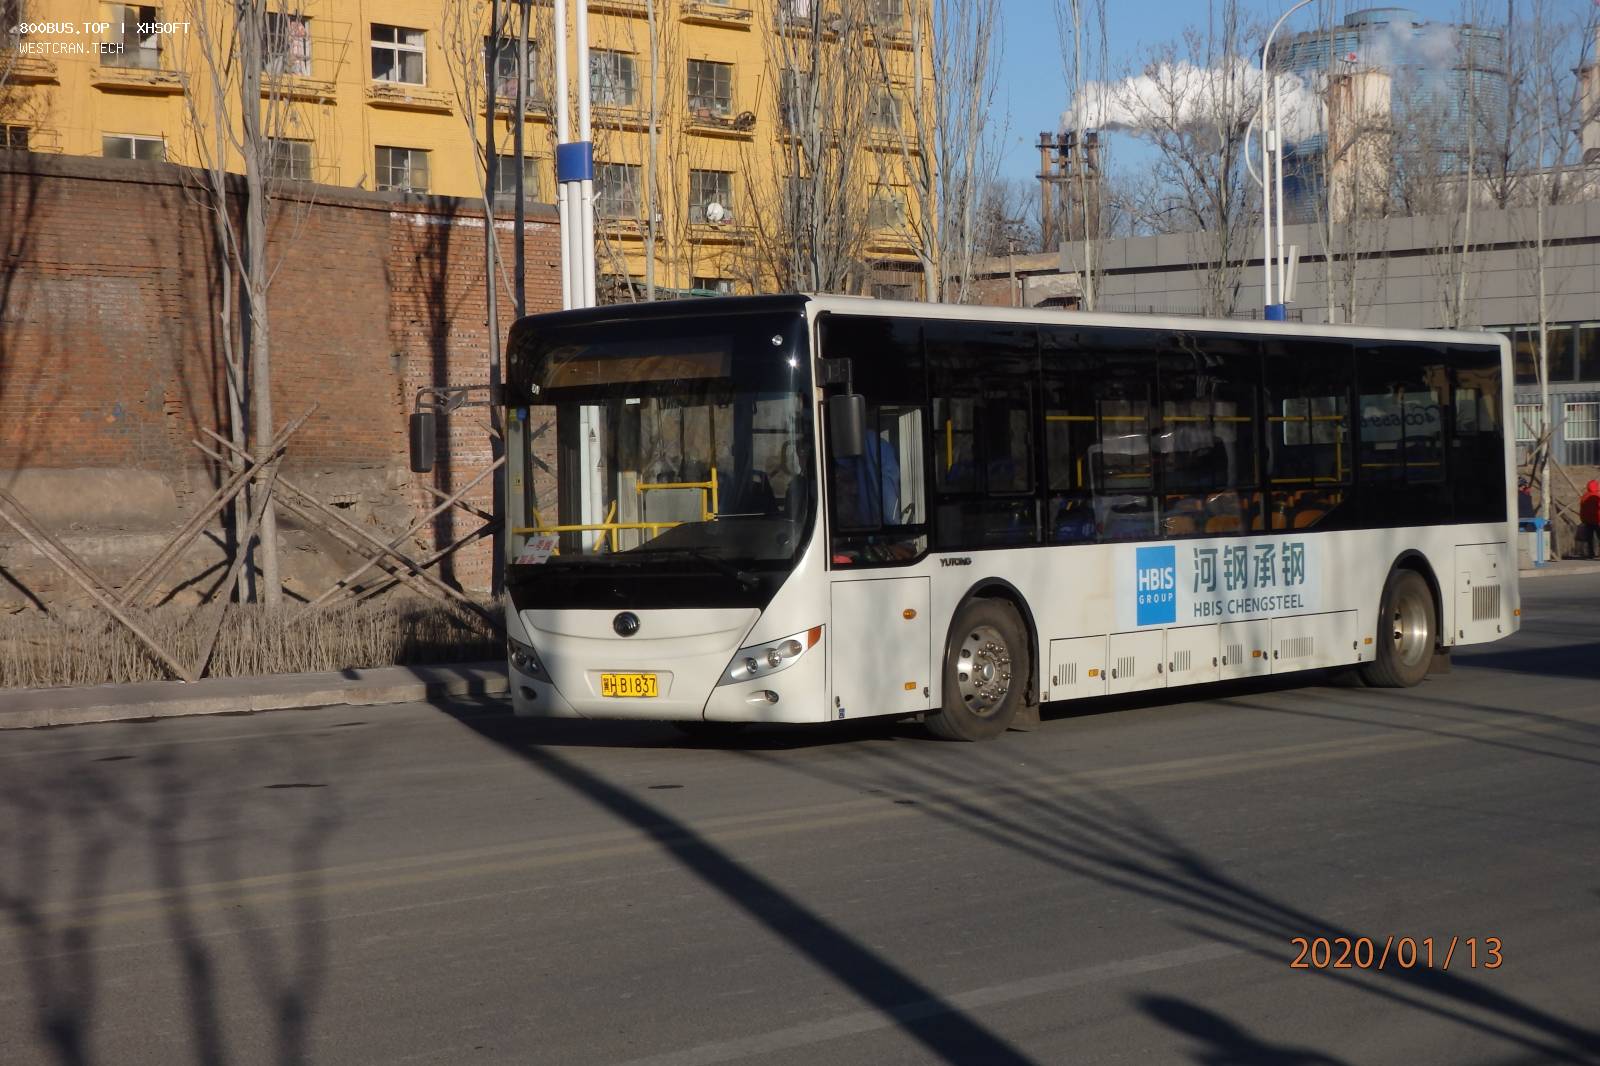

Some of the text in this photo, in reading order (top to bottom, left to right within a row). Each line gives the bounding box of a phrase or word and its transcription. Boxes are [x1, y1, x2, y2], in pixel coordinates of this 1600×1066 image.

[939, 557, 973, 567] YUTONG
[1193, 541, 1305, 593] 河钢承钢
[1138, 567, 1173, 591] HBIS
[1139, 594, 1173, 605] GROUP
[1193, 594, 1304, 617] HBIS CHENGSTEEL
